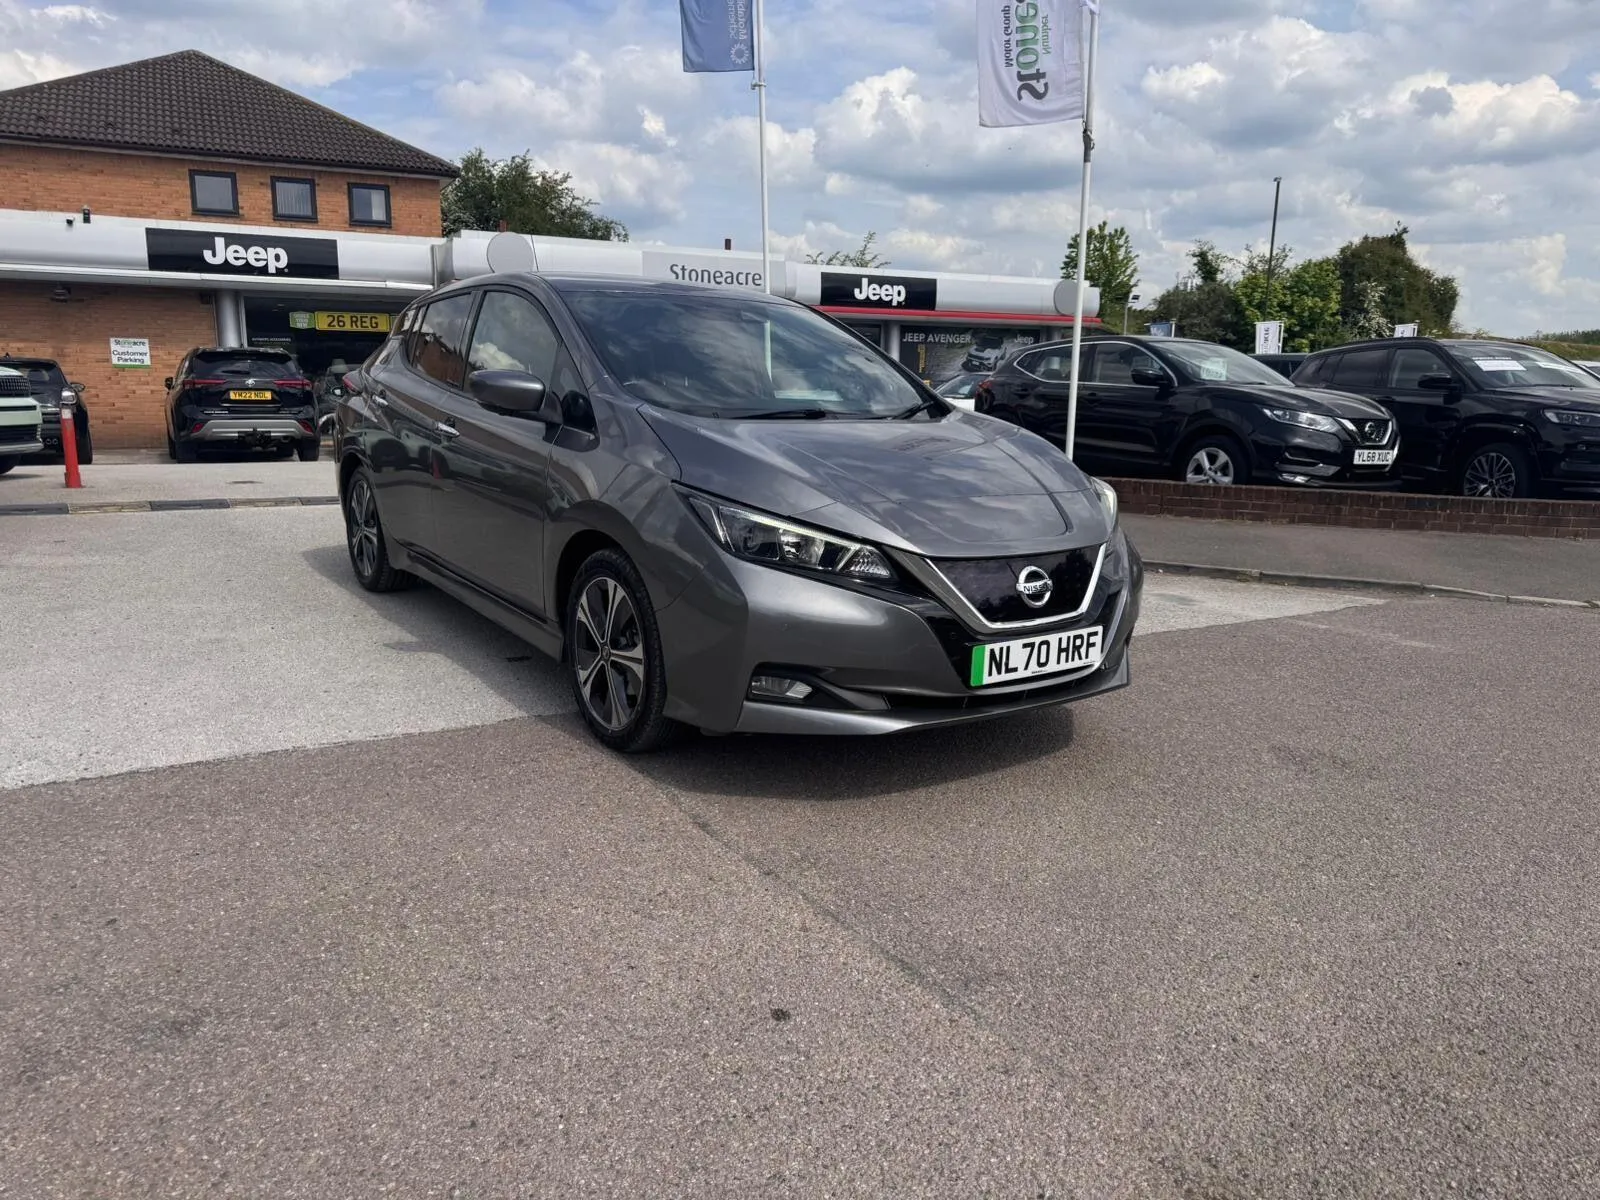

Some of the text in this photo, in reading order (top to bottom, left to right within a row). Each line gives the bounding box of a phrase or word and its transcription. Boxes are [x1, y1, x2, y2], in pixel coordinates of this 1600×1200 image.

[203, 236, 288, 274] Jeep
[669, 264, 762, 286] Stoneacre
[854, 277, 906, 306] Jeep
[327, 314, 379, 329] 26 REG
[902, 333, 971, 343] JEEP AVENGER
[1015, 334, 1034, 345] Jeep
[117, 356, 145, 364] Parking
[987, 631, 1099, 677] NL70 HRF
